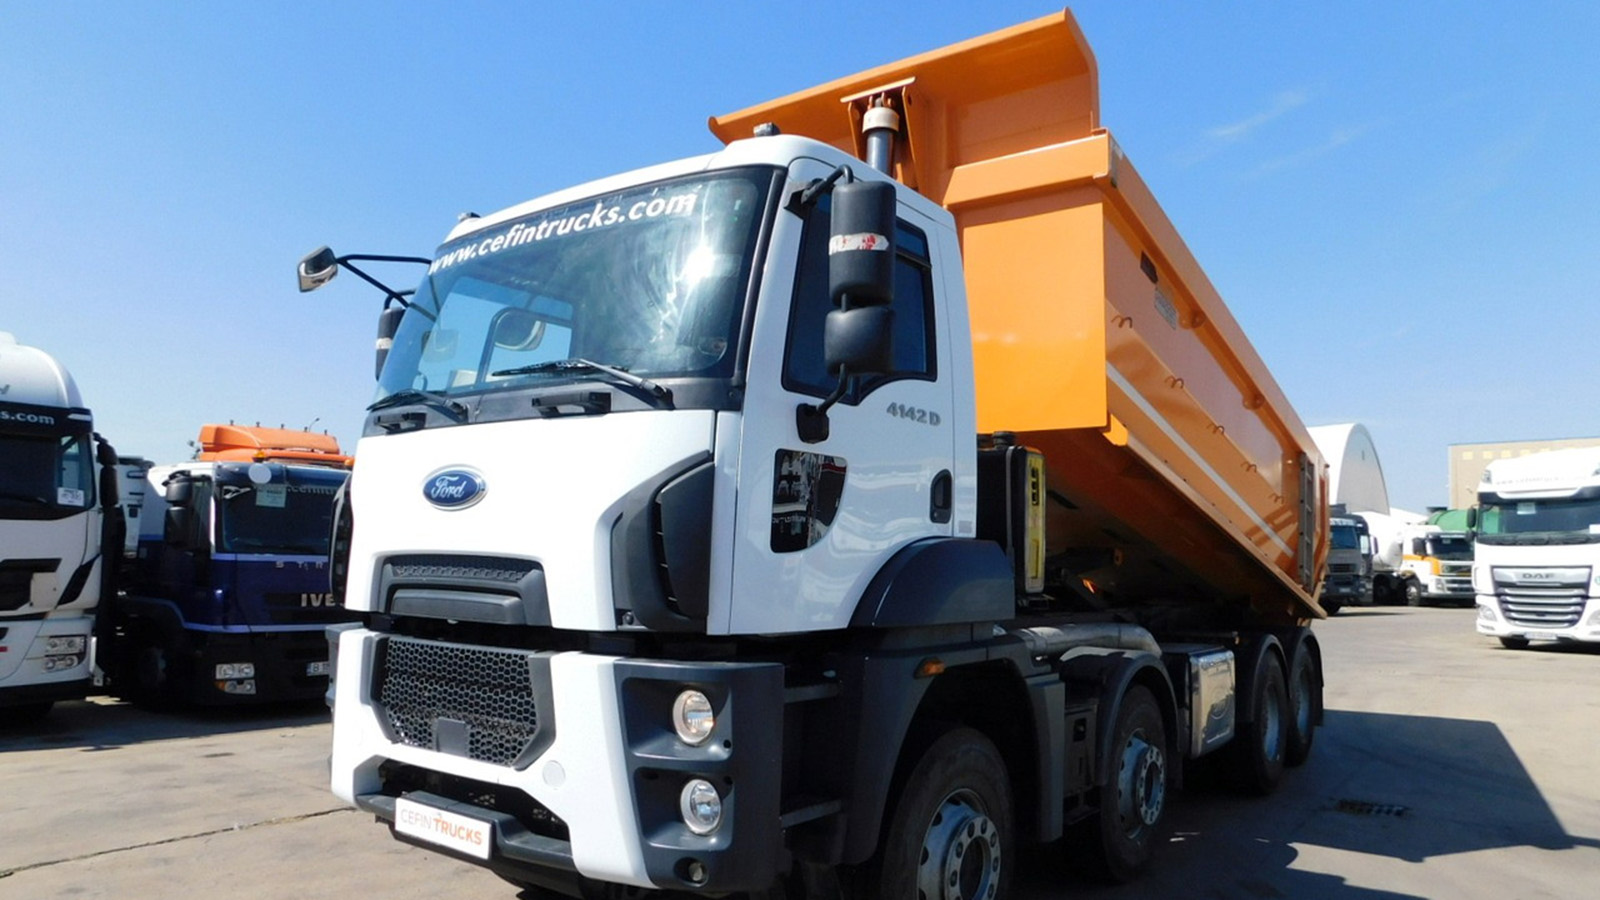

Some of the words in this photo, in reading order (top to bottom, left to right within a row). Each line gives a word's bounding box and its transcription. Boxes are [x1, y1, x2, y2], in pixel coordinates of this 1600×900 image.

[427, 191, 698, 276] www.cefintrucks.com
[431, 475, 467, 499] Ford
[301, 593, 345, 607] IVE
[400, 808, 433, 830] CEFIN
[433, 817, 482, 845] TRUCKS
